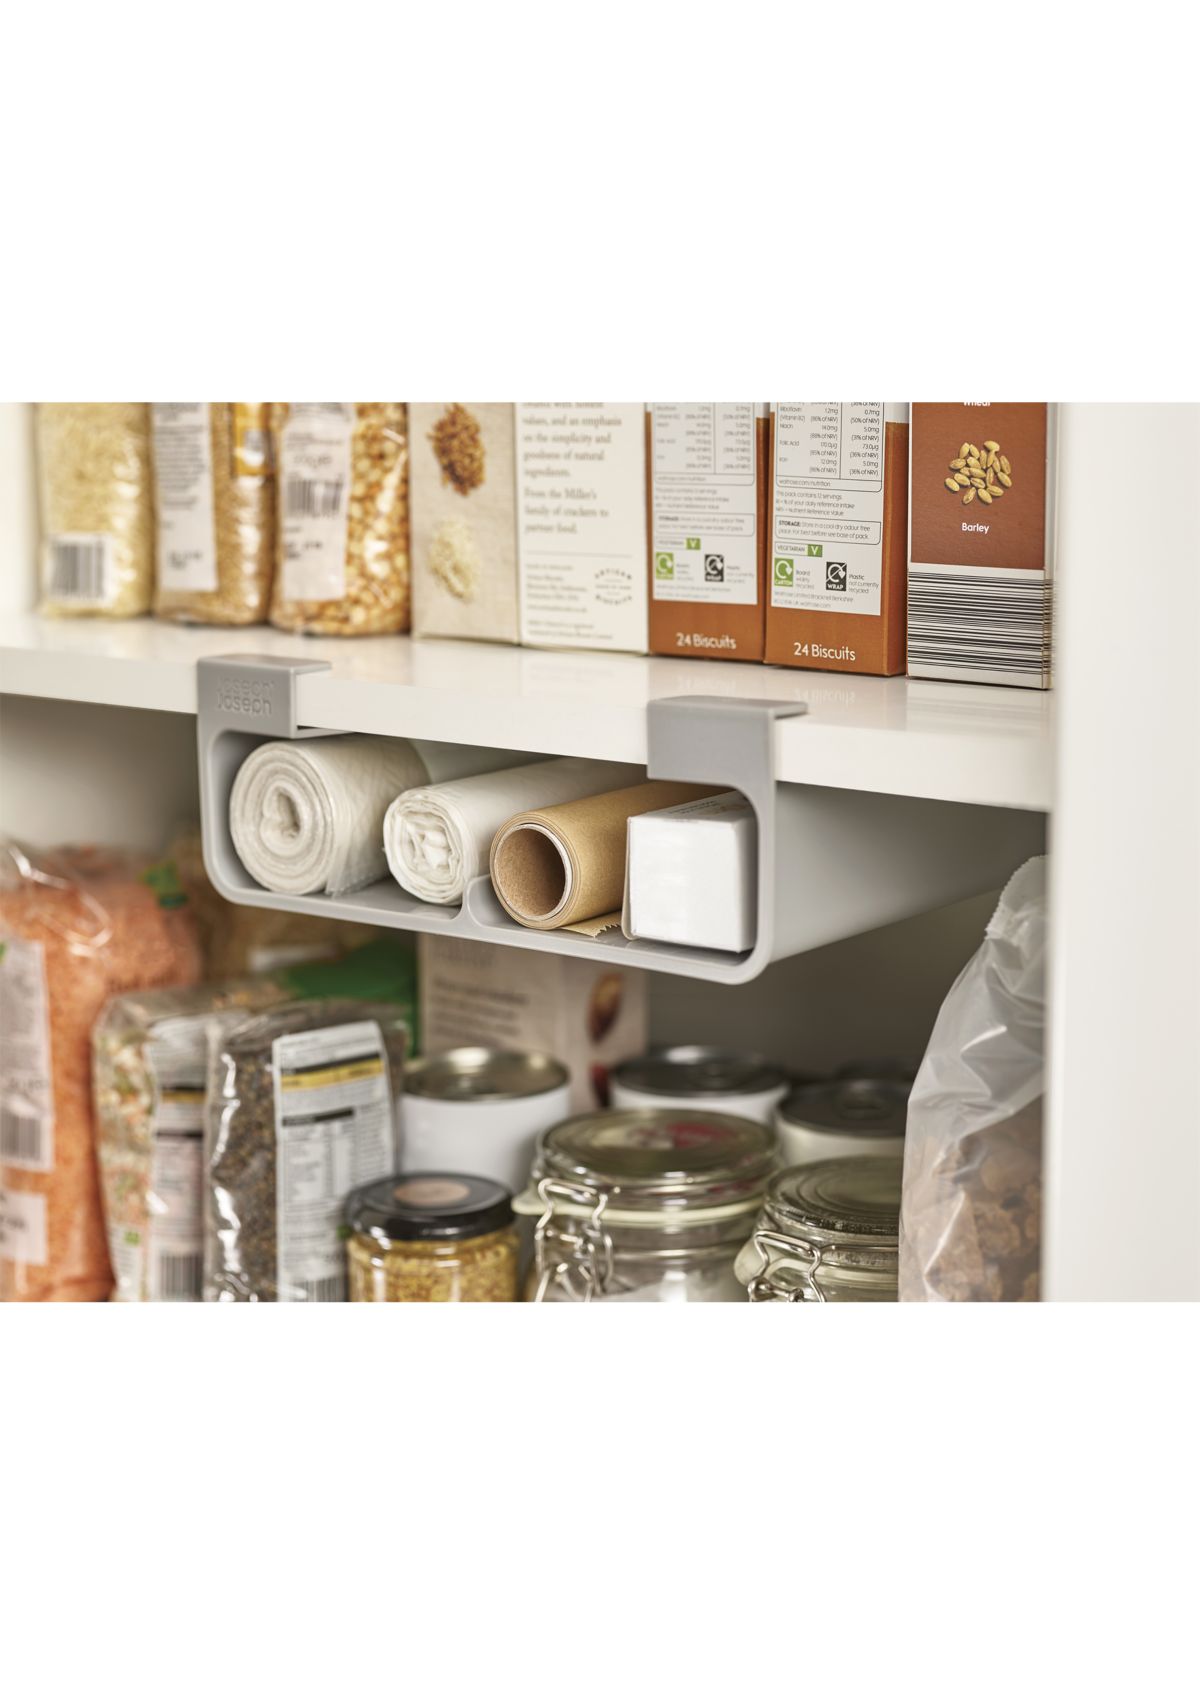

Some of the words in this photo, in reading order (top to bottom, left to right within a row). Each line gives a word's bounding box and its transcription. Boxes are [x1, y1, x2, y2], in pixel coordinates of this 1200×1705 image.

[961, 522, 990, 534] Barley
[810, 545, 818, 556] V
[676, 632, 691, 647] 24
[693, 633, 737, 650] Biscuits
[793, 642, 809, 657] 24
[811, 643, 856, 661] Biscuits
